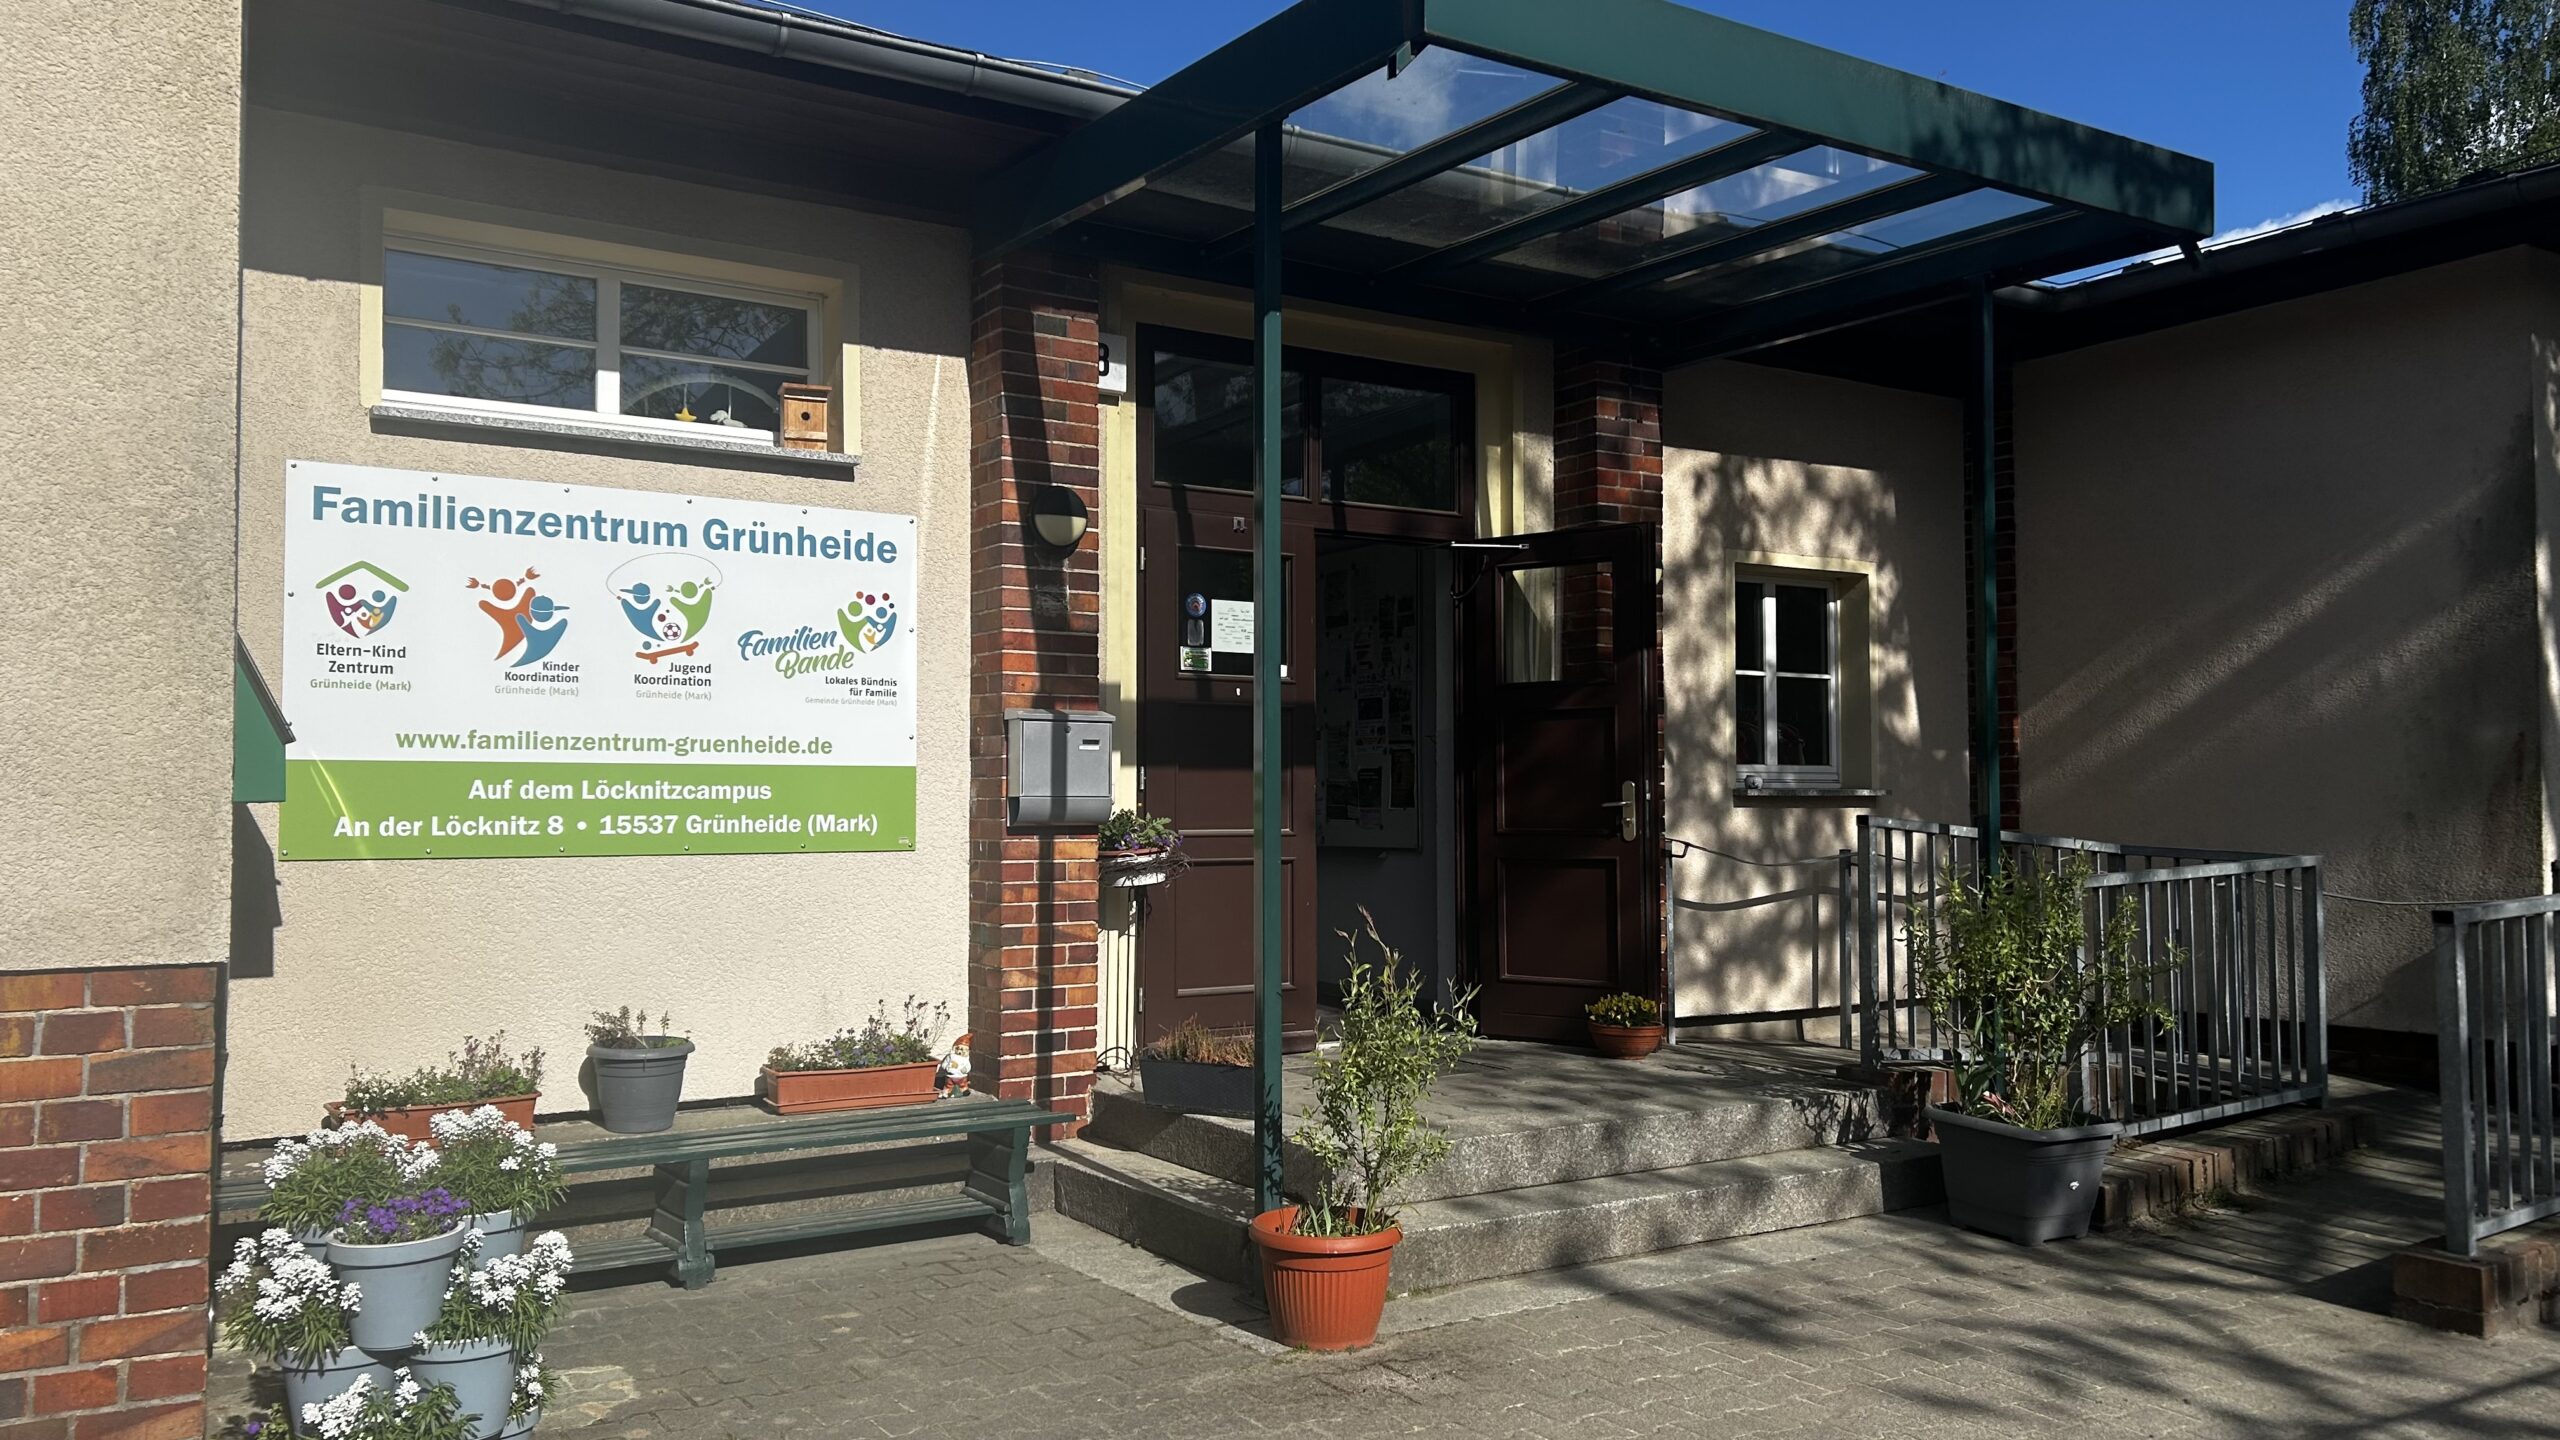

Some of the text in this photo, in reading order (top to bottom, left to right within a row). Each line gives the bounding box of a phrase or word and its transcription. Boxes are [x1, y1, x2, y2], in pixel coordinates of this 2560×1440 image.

[313, 485, 898, 563] Familienzentrum Grünheide
[316, 643, 407, 658] Eltern-Kind
[737, 626, 837, 661] Familien
[328, 660, 394, 674] Zentrum
[542, 661, 580, 672] Kinder
[669, 662, 712, 675] Jugend
[775, 644, 854, 679] Bande
[504, 671, 579, 683] Koordination
[634, 674, 712, 687] Koordination
[825, 676, 898, 687] Lokales Bündnis
[310, 678, 412, 692] Grünheide (Mark)
[494, 685, 579, 697] Grünheide (Mark)
[635, 690, 712, 701] Grünheide (Mark)
[849, 688, 898, 698] für Familie
[395, 729, 833, 756] www.familienzentrum-gruenheide.de
[469, 779, 772, 803] Auf dem Löcknitzcampus
[334, 813, 878, 837] An der Löcknitz 8 15537 Grünheide (Mark)
